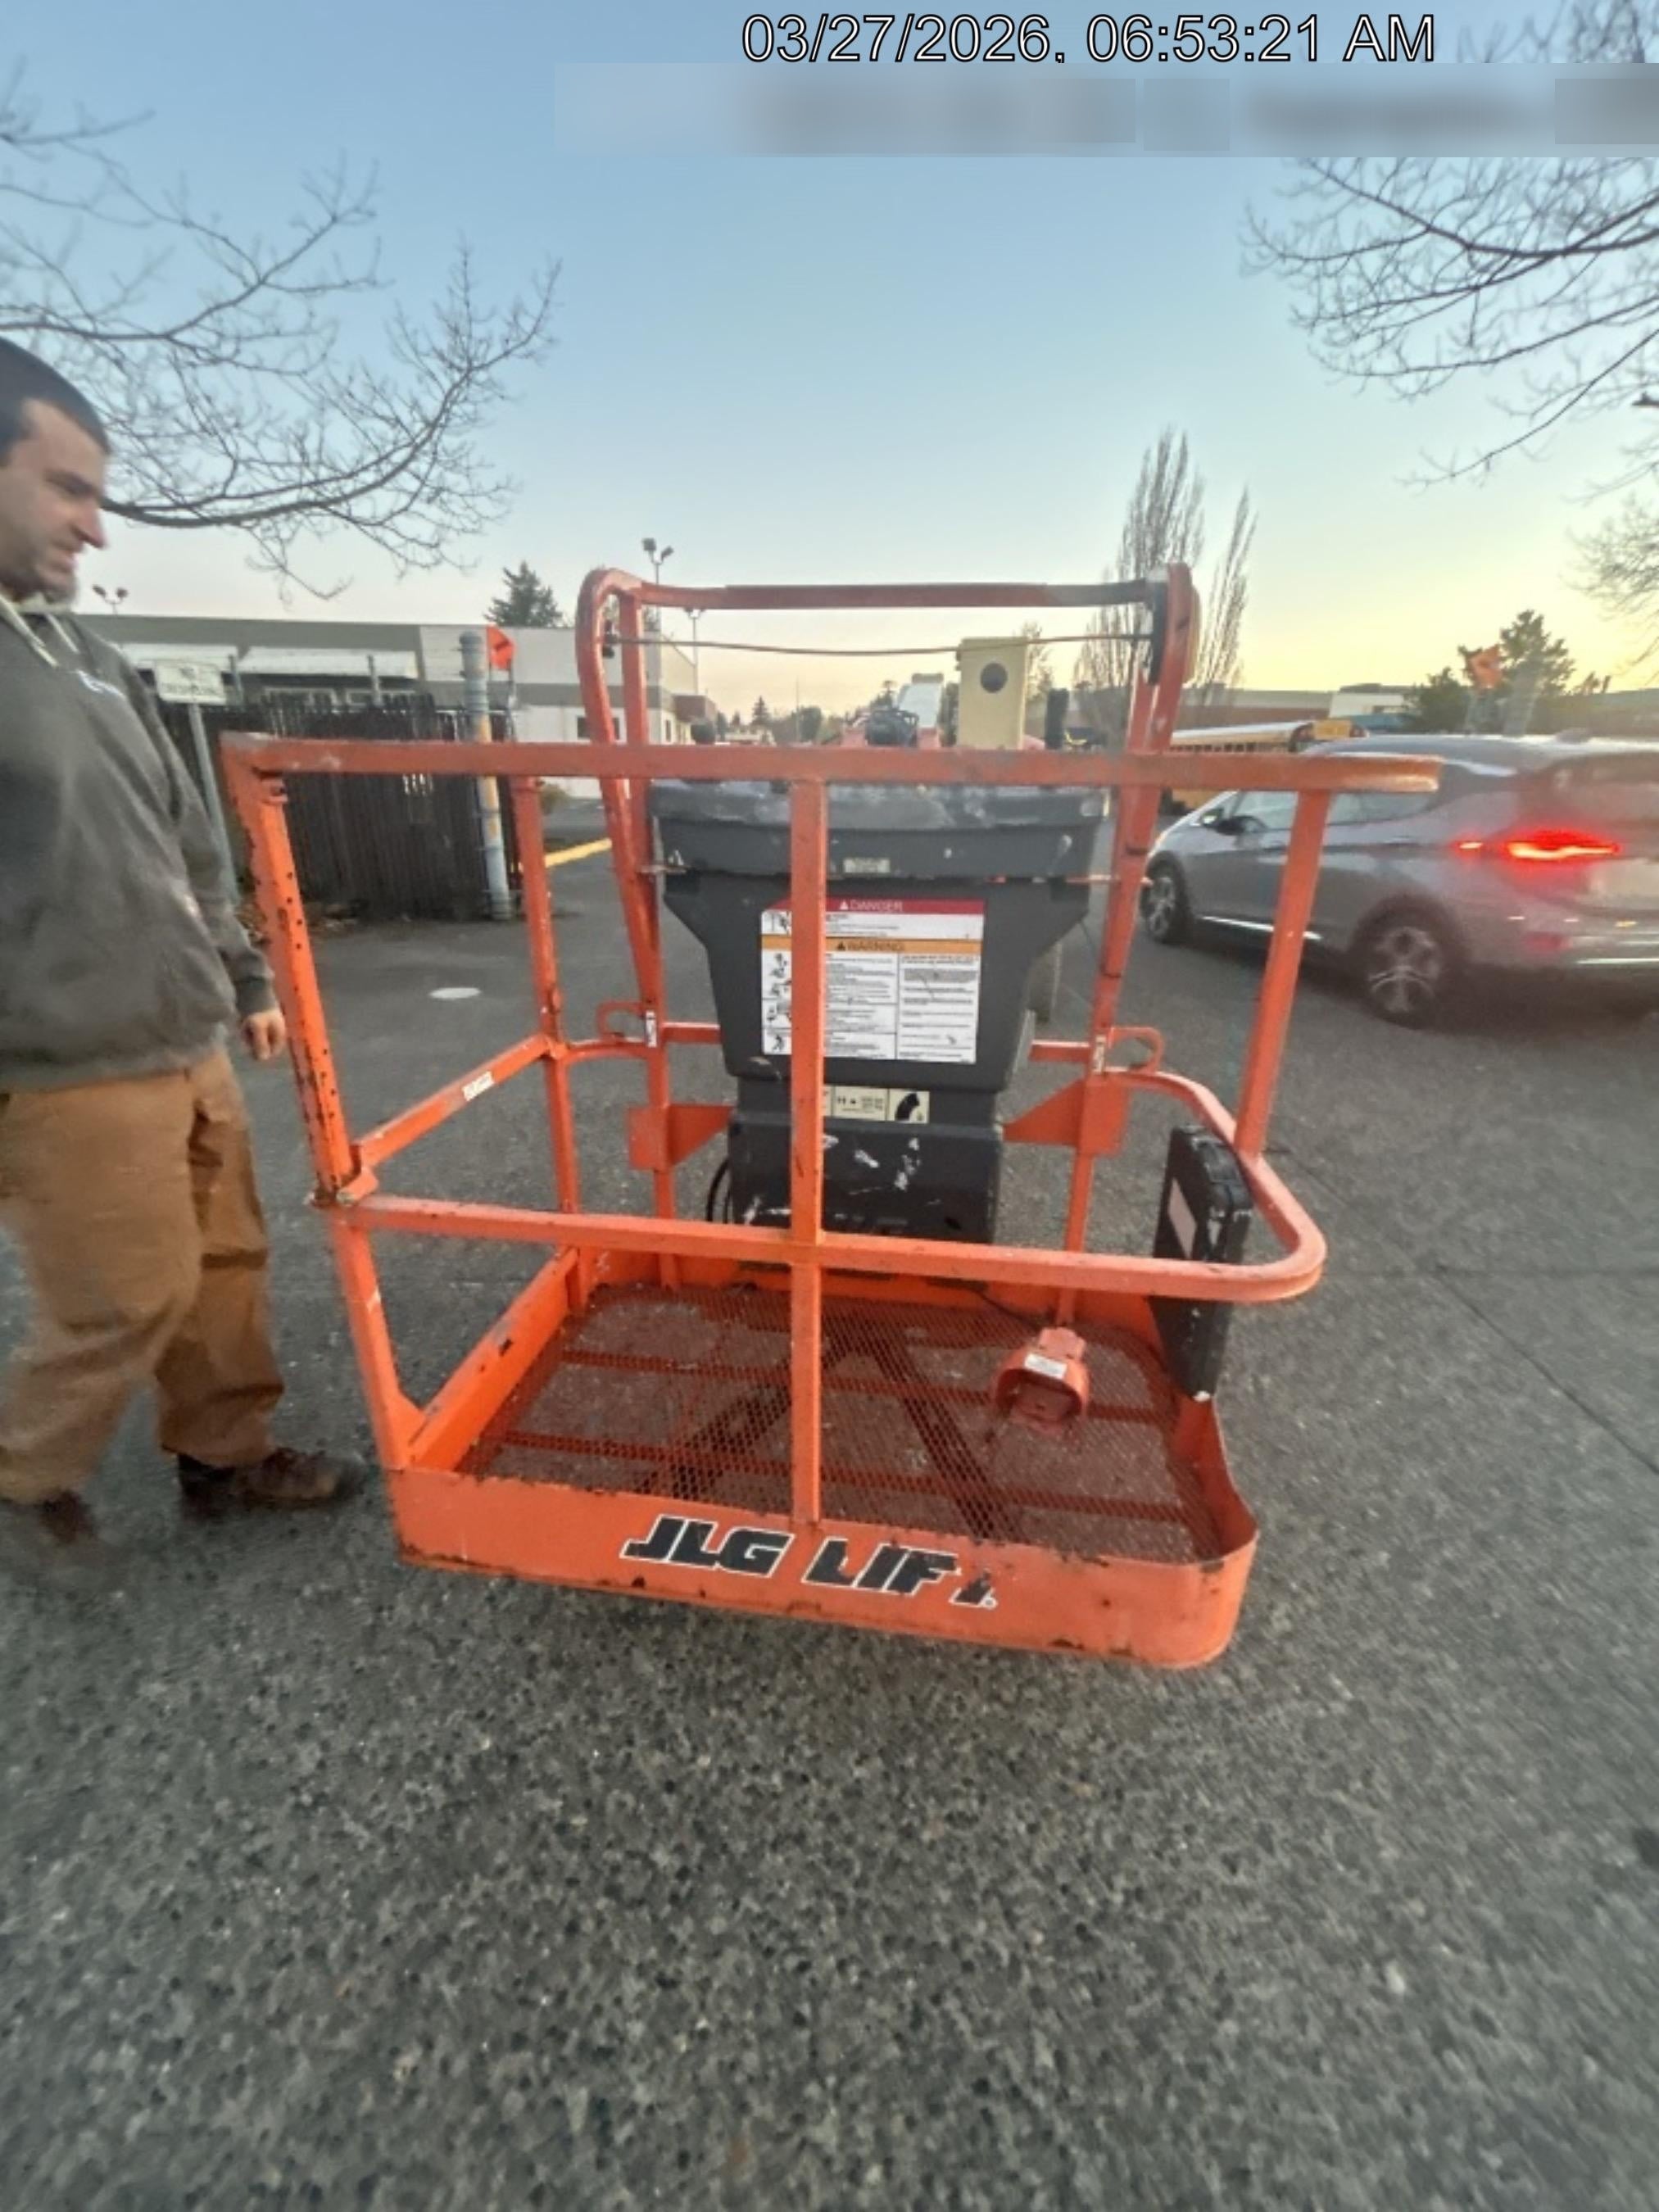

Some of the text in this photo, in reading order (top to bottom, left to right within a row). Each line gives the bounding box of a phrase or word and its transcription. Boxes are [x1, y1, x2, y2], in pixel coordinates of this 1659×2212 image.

[850, 899, 903, 911] DANGER
[847, 940, 904, 952] WARNING
[619, 1514, 794, 1578] JLG
